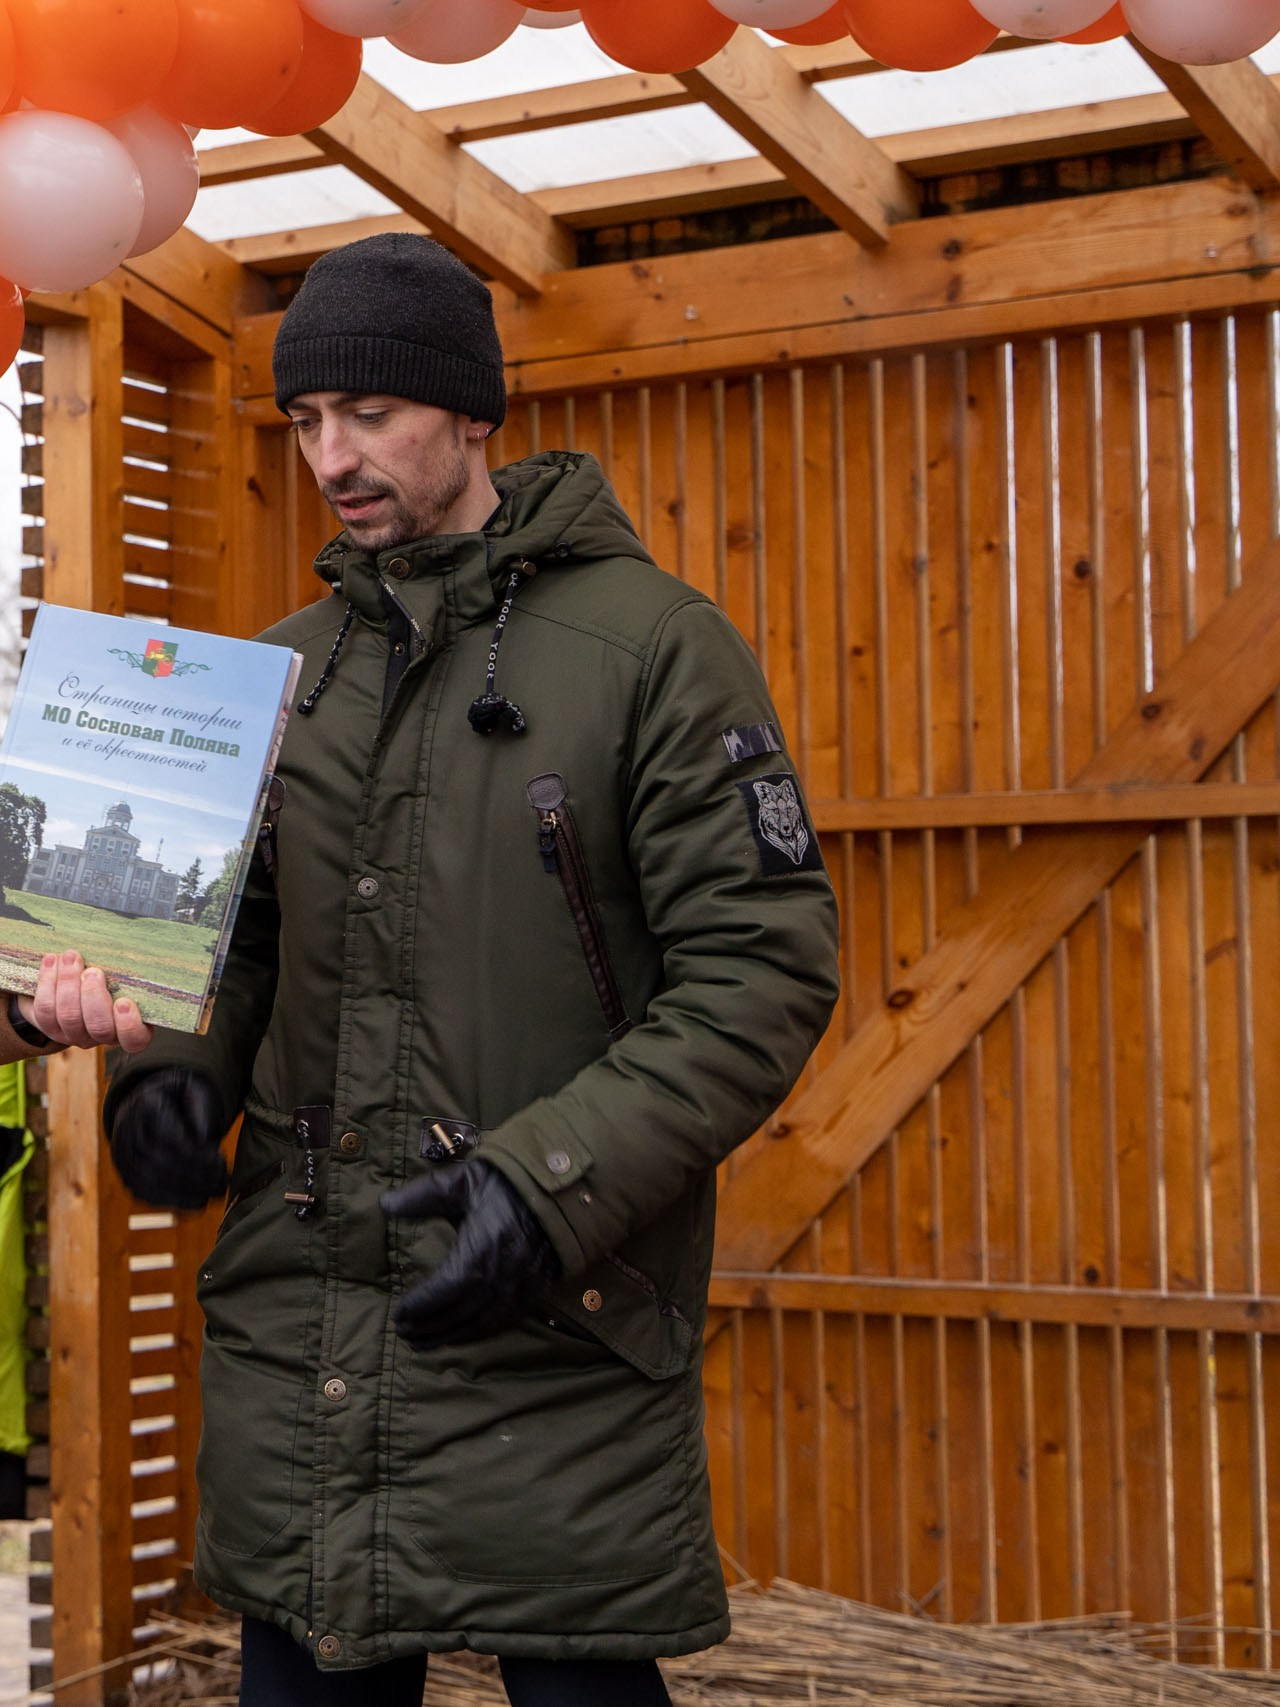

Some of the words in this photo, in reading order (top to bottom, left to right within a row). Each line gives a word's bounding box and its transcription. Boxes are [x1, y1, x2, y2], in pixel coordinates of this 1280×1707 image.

[58, 671, 158, 715] Страницы
[161, 706, 243, 731] истории
[41, 703, 72, 725] МО
[75, 710, 166, 743] Сосновая
[169, 727, 241, 758] Поляна
[61, 737, 73, 748] и
[75, 738, 94, 751] её
[94, 737, 208, 773] окрестностей
